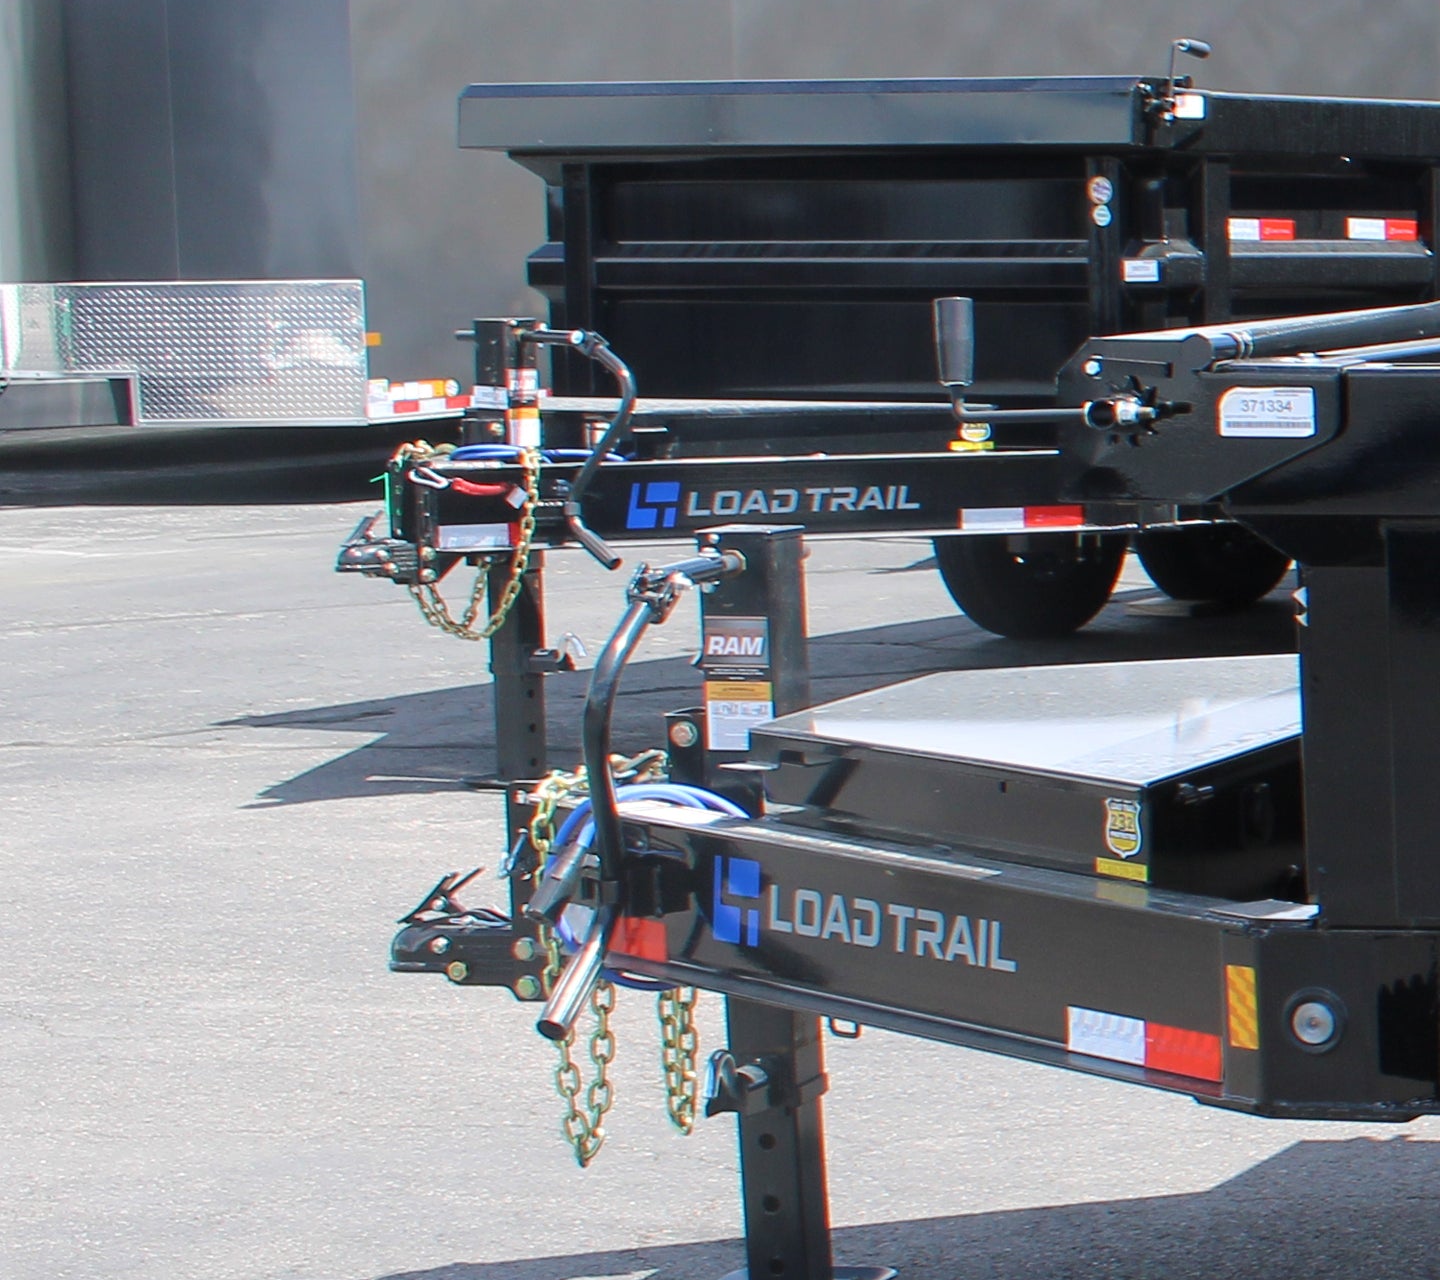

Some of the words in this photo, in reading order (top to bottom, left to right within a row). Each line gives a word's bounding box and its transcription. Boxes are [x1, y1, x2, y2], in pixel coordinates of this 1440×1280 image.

[1241, 400, 1294, 412] 371334
[686, 489, 799, 517] LOAD
[805, 485, 920, 513] TRAIL
[707, 636, 764, 656] RAM
[768, 884, 881, 948] LOAD
[887, 902, 1017, 972] TRAIL
